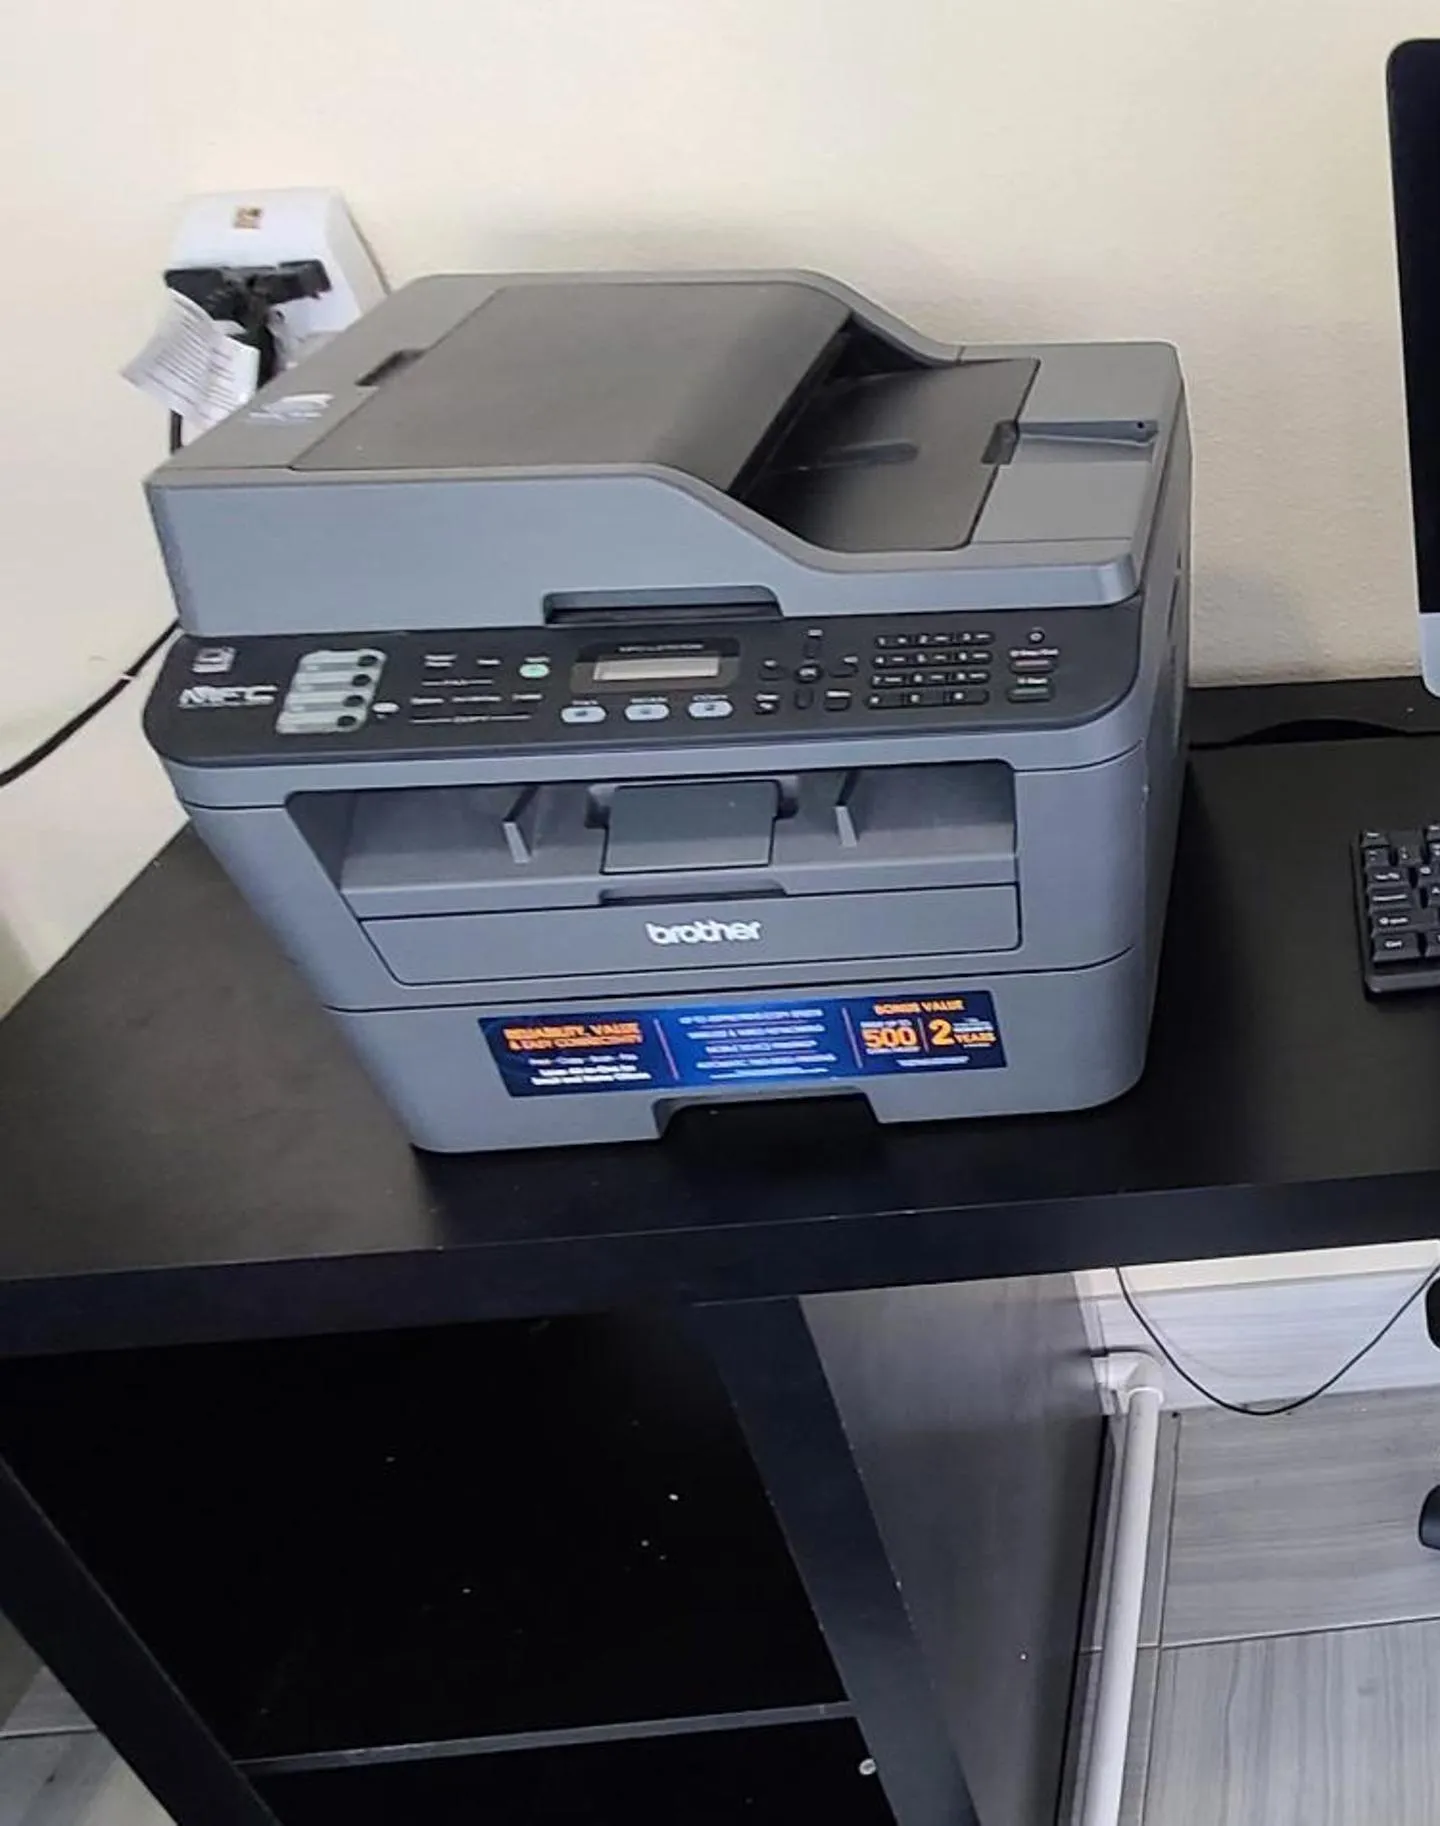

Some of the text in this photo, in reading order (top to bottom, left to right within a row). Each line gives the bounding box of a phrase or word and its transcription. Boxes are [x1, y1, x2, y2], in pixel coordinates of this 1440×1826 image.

[644, 920, 762, 945] brother
[861, 1026, 918, 1049] 500
[928, 1018, 956, 1047] 2
